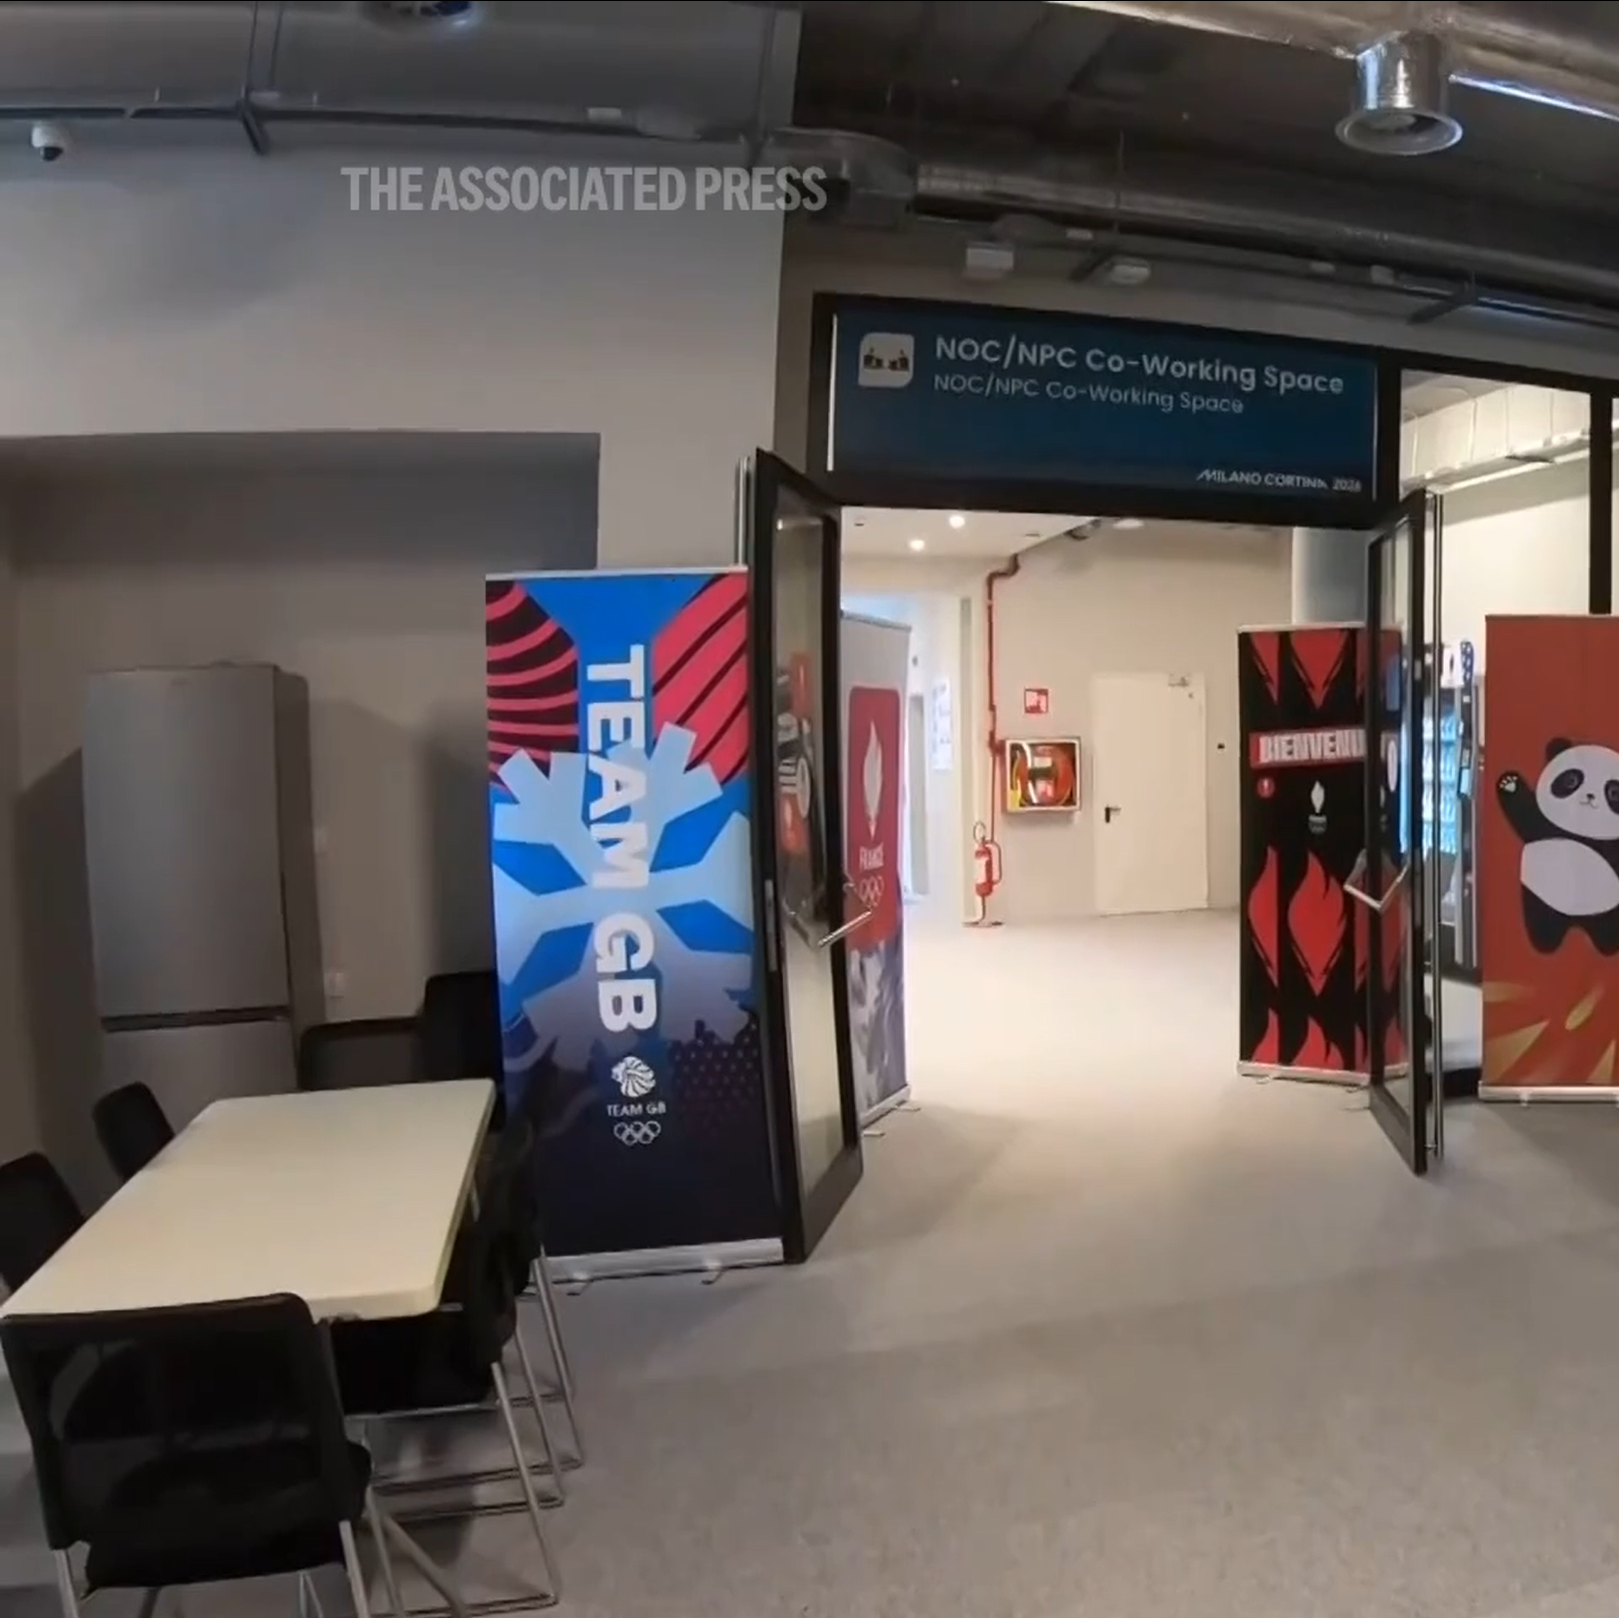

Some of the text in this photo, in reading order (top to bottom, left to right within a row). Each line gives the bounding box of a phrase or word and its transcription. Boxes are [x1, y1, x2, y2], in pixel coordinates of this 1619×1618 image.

[936, 334, 1344, 396] NOC/NPC Co-Working Space
[934, 374, 1244, 415] NOC/NPC Co-Working Space
[1196, 469, 1262, 485] MILANO
[1264, 473, 1328, 489] CORTINA
[585, 643, 658, 1033] TEAM GB
[607, 1101, 667, 1117] TEAM GB
